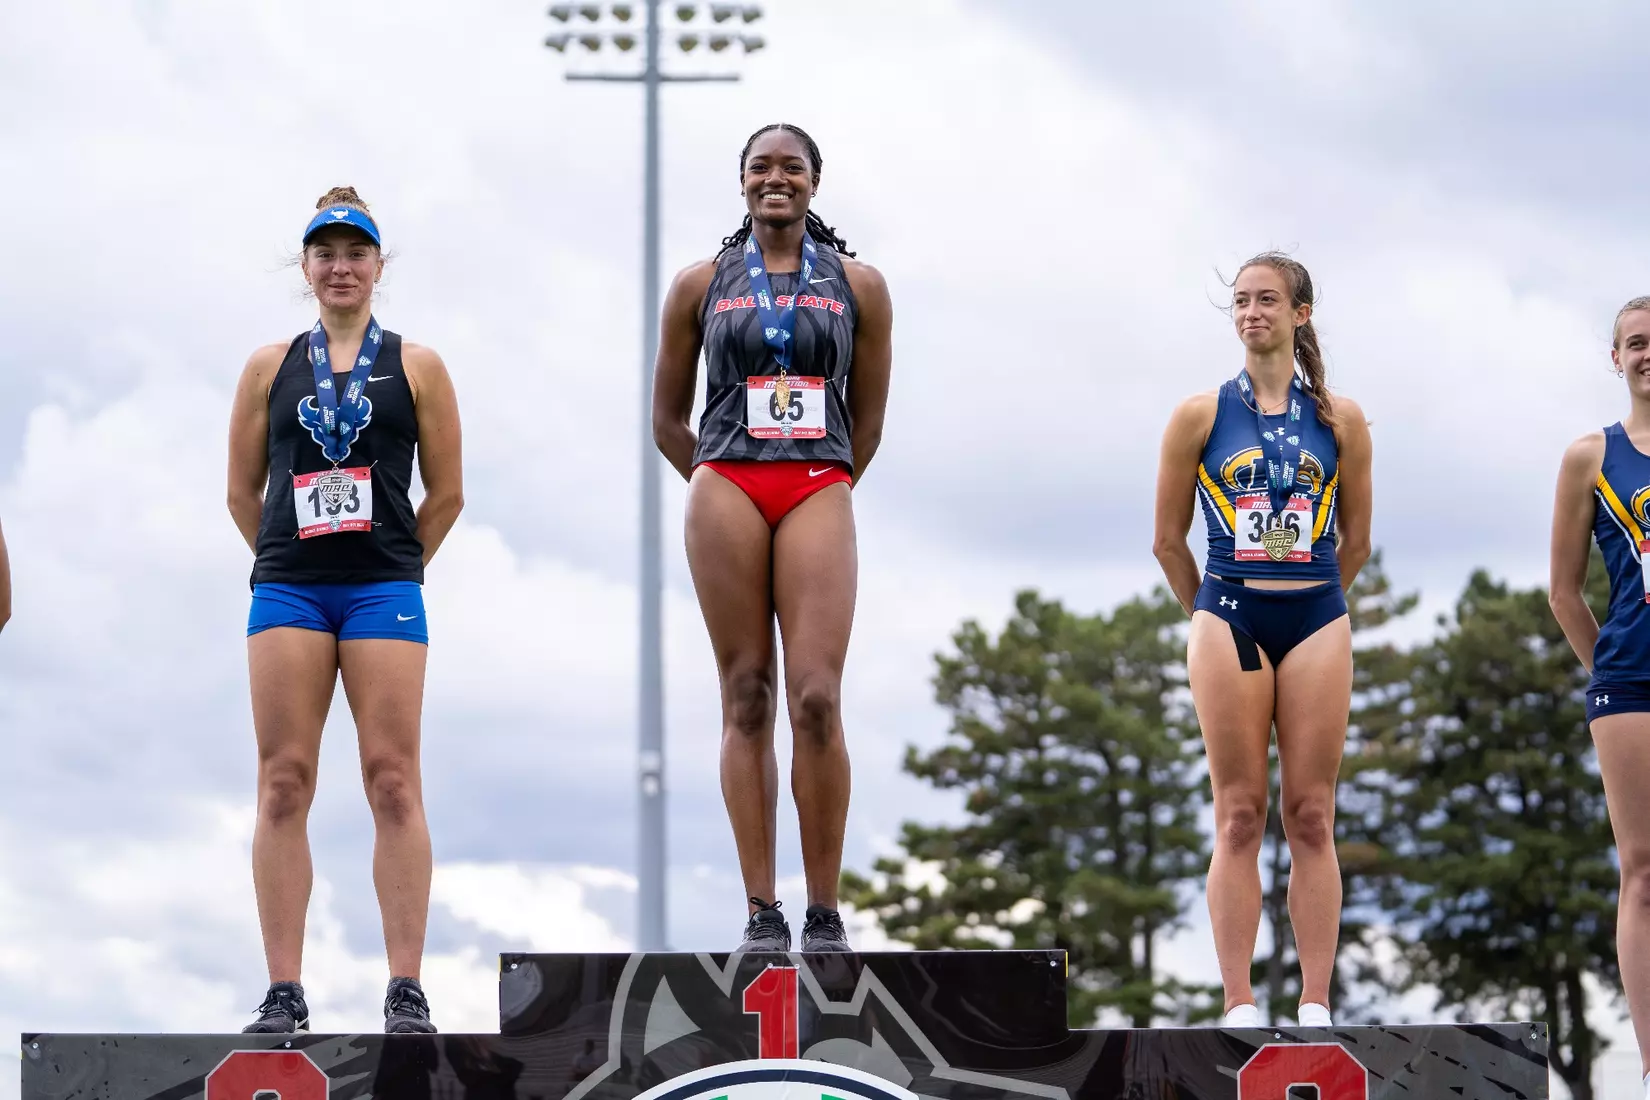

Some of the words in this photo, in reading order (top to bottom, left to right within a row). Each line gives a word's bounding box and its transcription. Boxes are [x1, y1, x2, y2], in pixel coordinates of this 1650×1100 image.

[714, 295, 757, 314] BAL
[769, 390, 804, 421] 65
[743, 966, 799, 1060] 1
